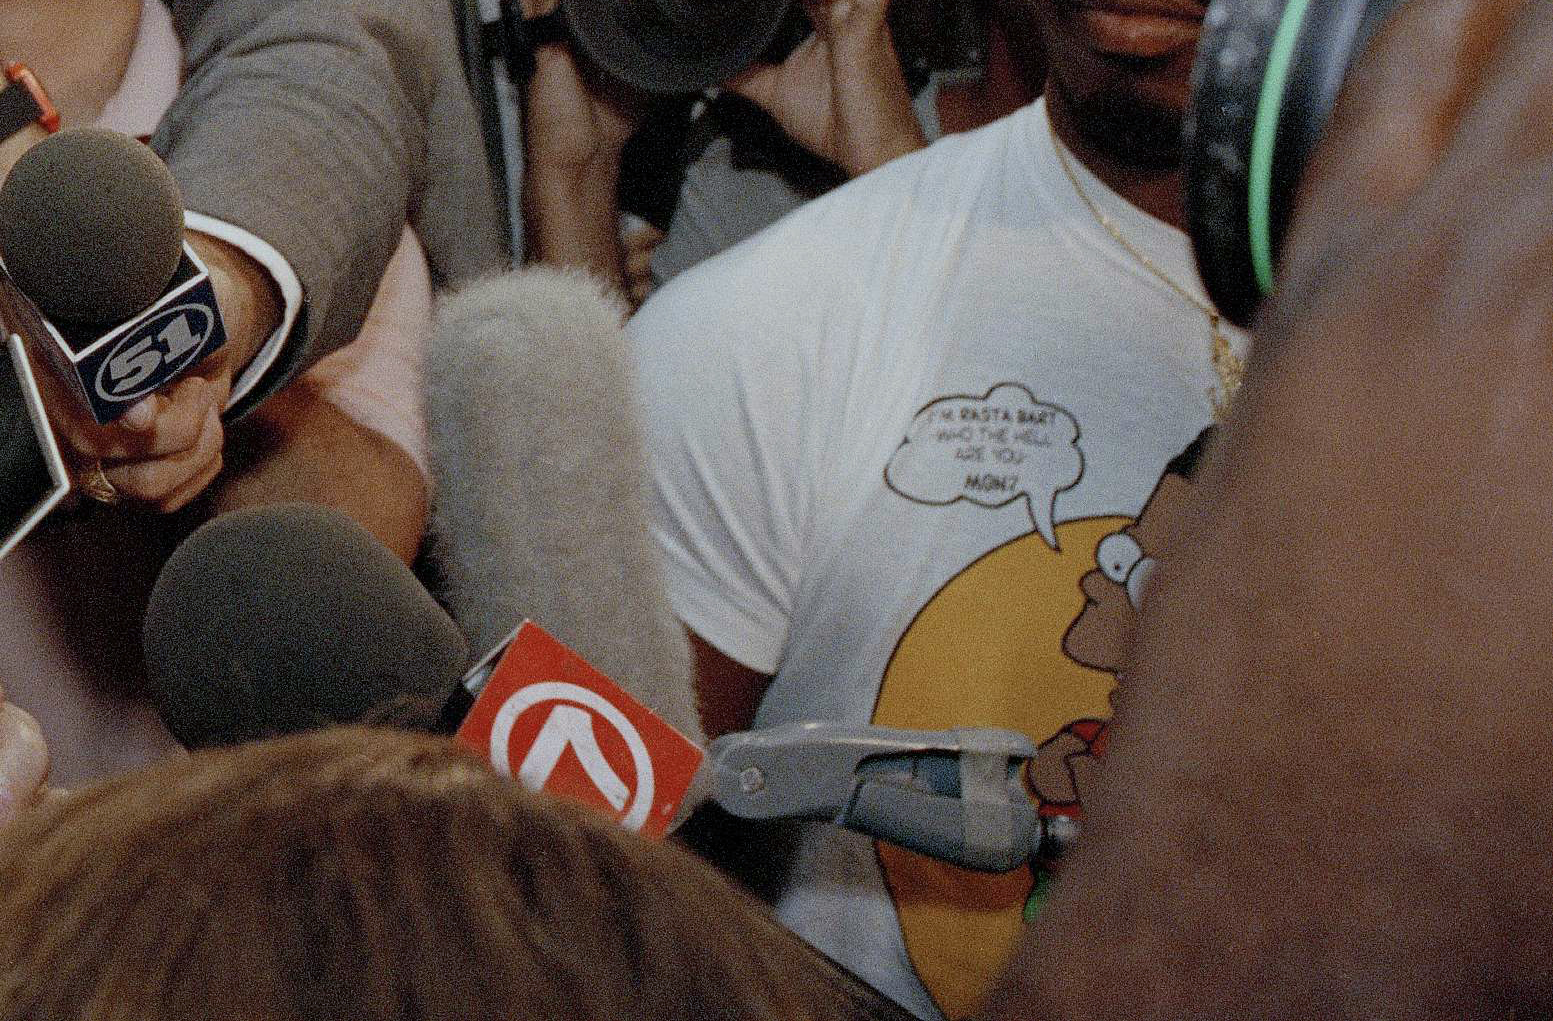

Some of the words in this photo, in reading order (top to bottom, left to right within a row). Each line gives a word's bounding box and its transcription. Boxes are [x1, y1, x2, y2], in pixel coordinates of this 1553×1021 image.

[107, 311, 204, 393] 51
[960, 406, 1011, 423] RASTA
[1016, 408, 1057, 425] BART
[954, 445, 986, 463] ARE
